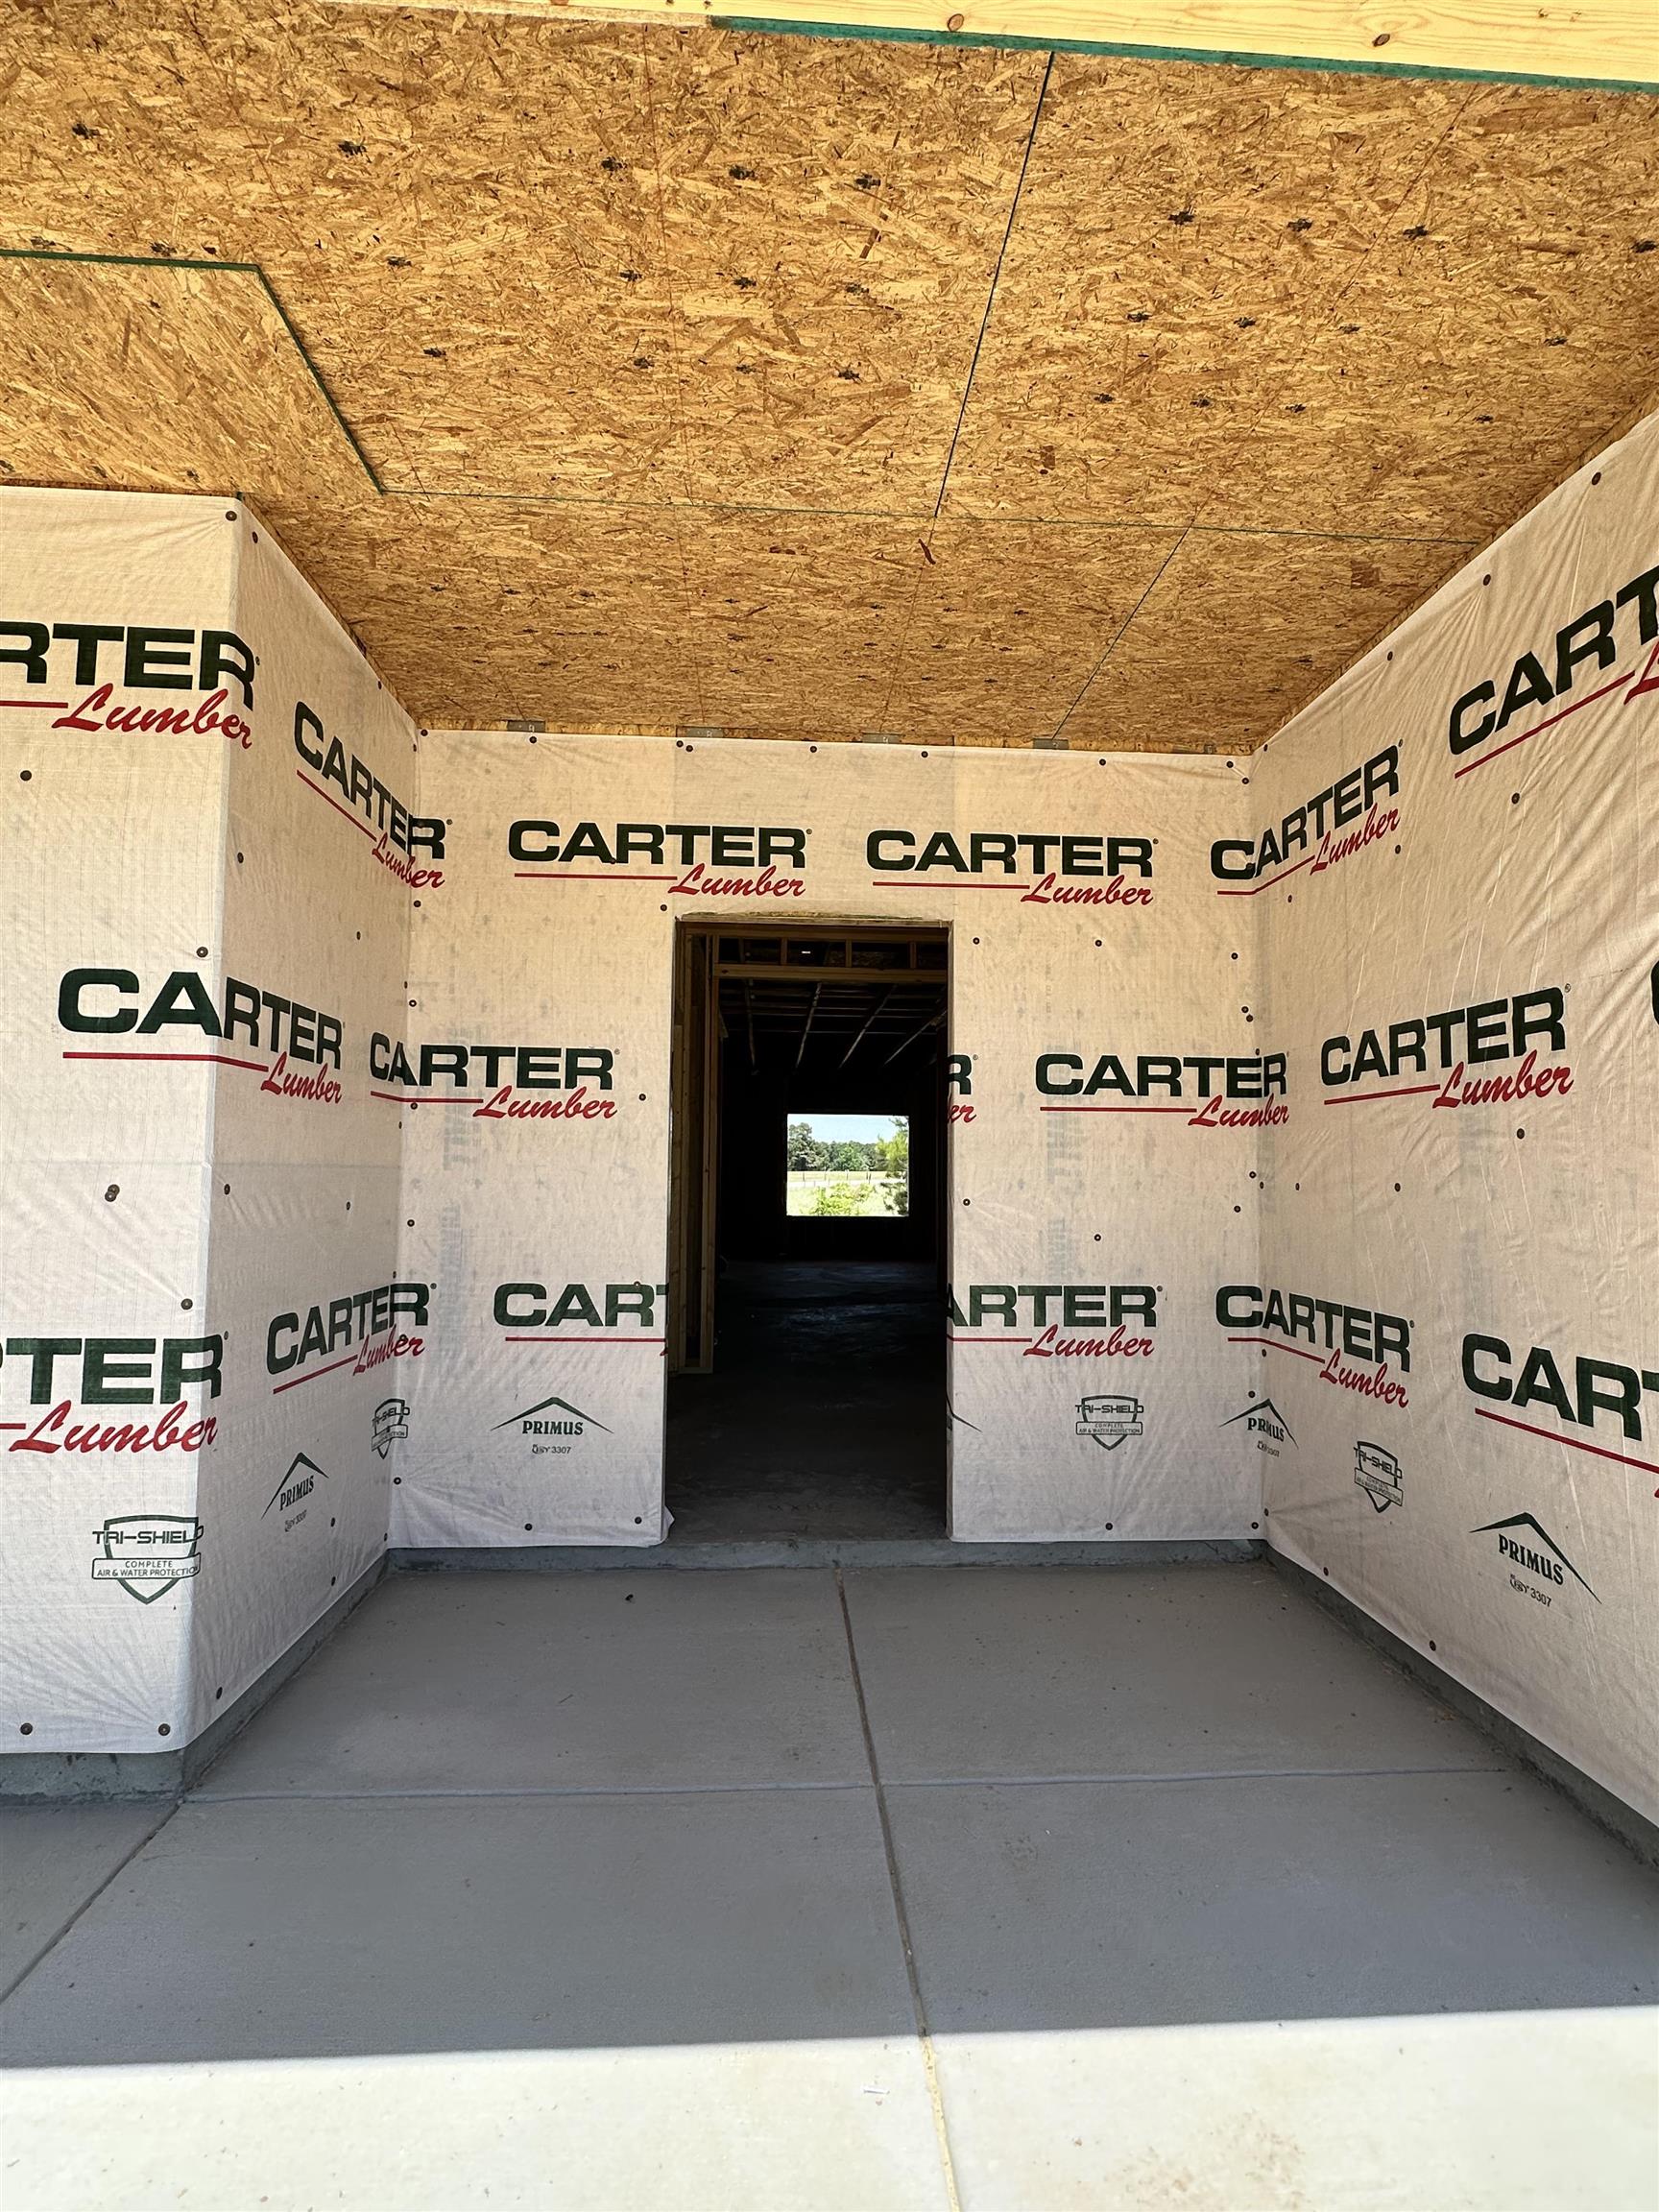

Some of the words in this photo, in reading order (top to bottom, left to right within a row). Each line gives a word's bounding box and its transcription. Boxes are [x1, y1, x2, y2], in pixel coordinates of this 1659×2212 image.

[51, 683, 252, 750] Lumber
[295, 701, 445, 859] CARTER
[1211, 745, 1400, 880] CARTER
[372, 831, 445, 889] Lumber
[509, 821, 806, 868] CARTER
[866, 830, 1153, 878] CARTER
[1310, 804, 1401, 875] Lumber
[667, 863, 805, 897] Lumber
[1021, 873, 1153, 905] Lumber
[59, 968, 343, 1070] CARTER
[1321, 987, 1567, 1087] CARTER
[260, 1051, 342, 1104] Lumber
[370, 1032, 613, 1091] CARTER
[1035, 1052, 1287, 1099] CARTER
[1432, 1049, 1575, 1109] Lumber
[474, 1085, 617, 1119] Lumber
[1188, 1094, 1290, 1128] Lumber
[267, 1283, 430, 1376] CARTER
[351, 1322, 426, 1377] Lumber
[1022, 1324, 1156, 1358] Lumber
[1215, 1285, 1410, 1374] CARTER
[1317, 1347, 1411, 1409] Lumber
[8, 1399, 218, 1455] Lumber
[521, 1420, 584, 1435] PRIMUS
[1074, 1405, 1144, 1414] TRI-SHIELD
[551, 1446, 572, 1455] 3307
[279, 1475, 315, 1512] PRIMUS
[92, 1525, 204, 1544] TRI-SHIELD
[1498, 1533, 1564, 1586] PRIMUS
[97, 1569, 110, 1577] AIR
[111, 1569, 119, 1577] &
[120, 1568, 148, 1577] WATER
[1530, 1587, 1552, 1608] 3307
